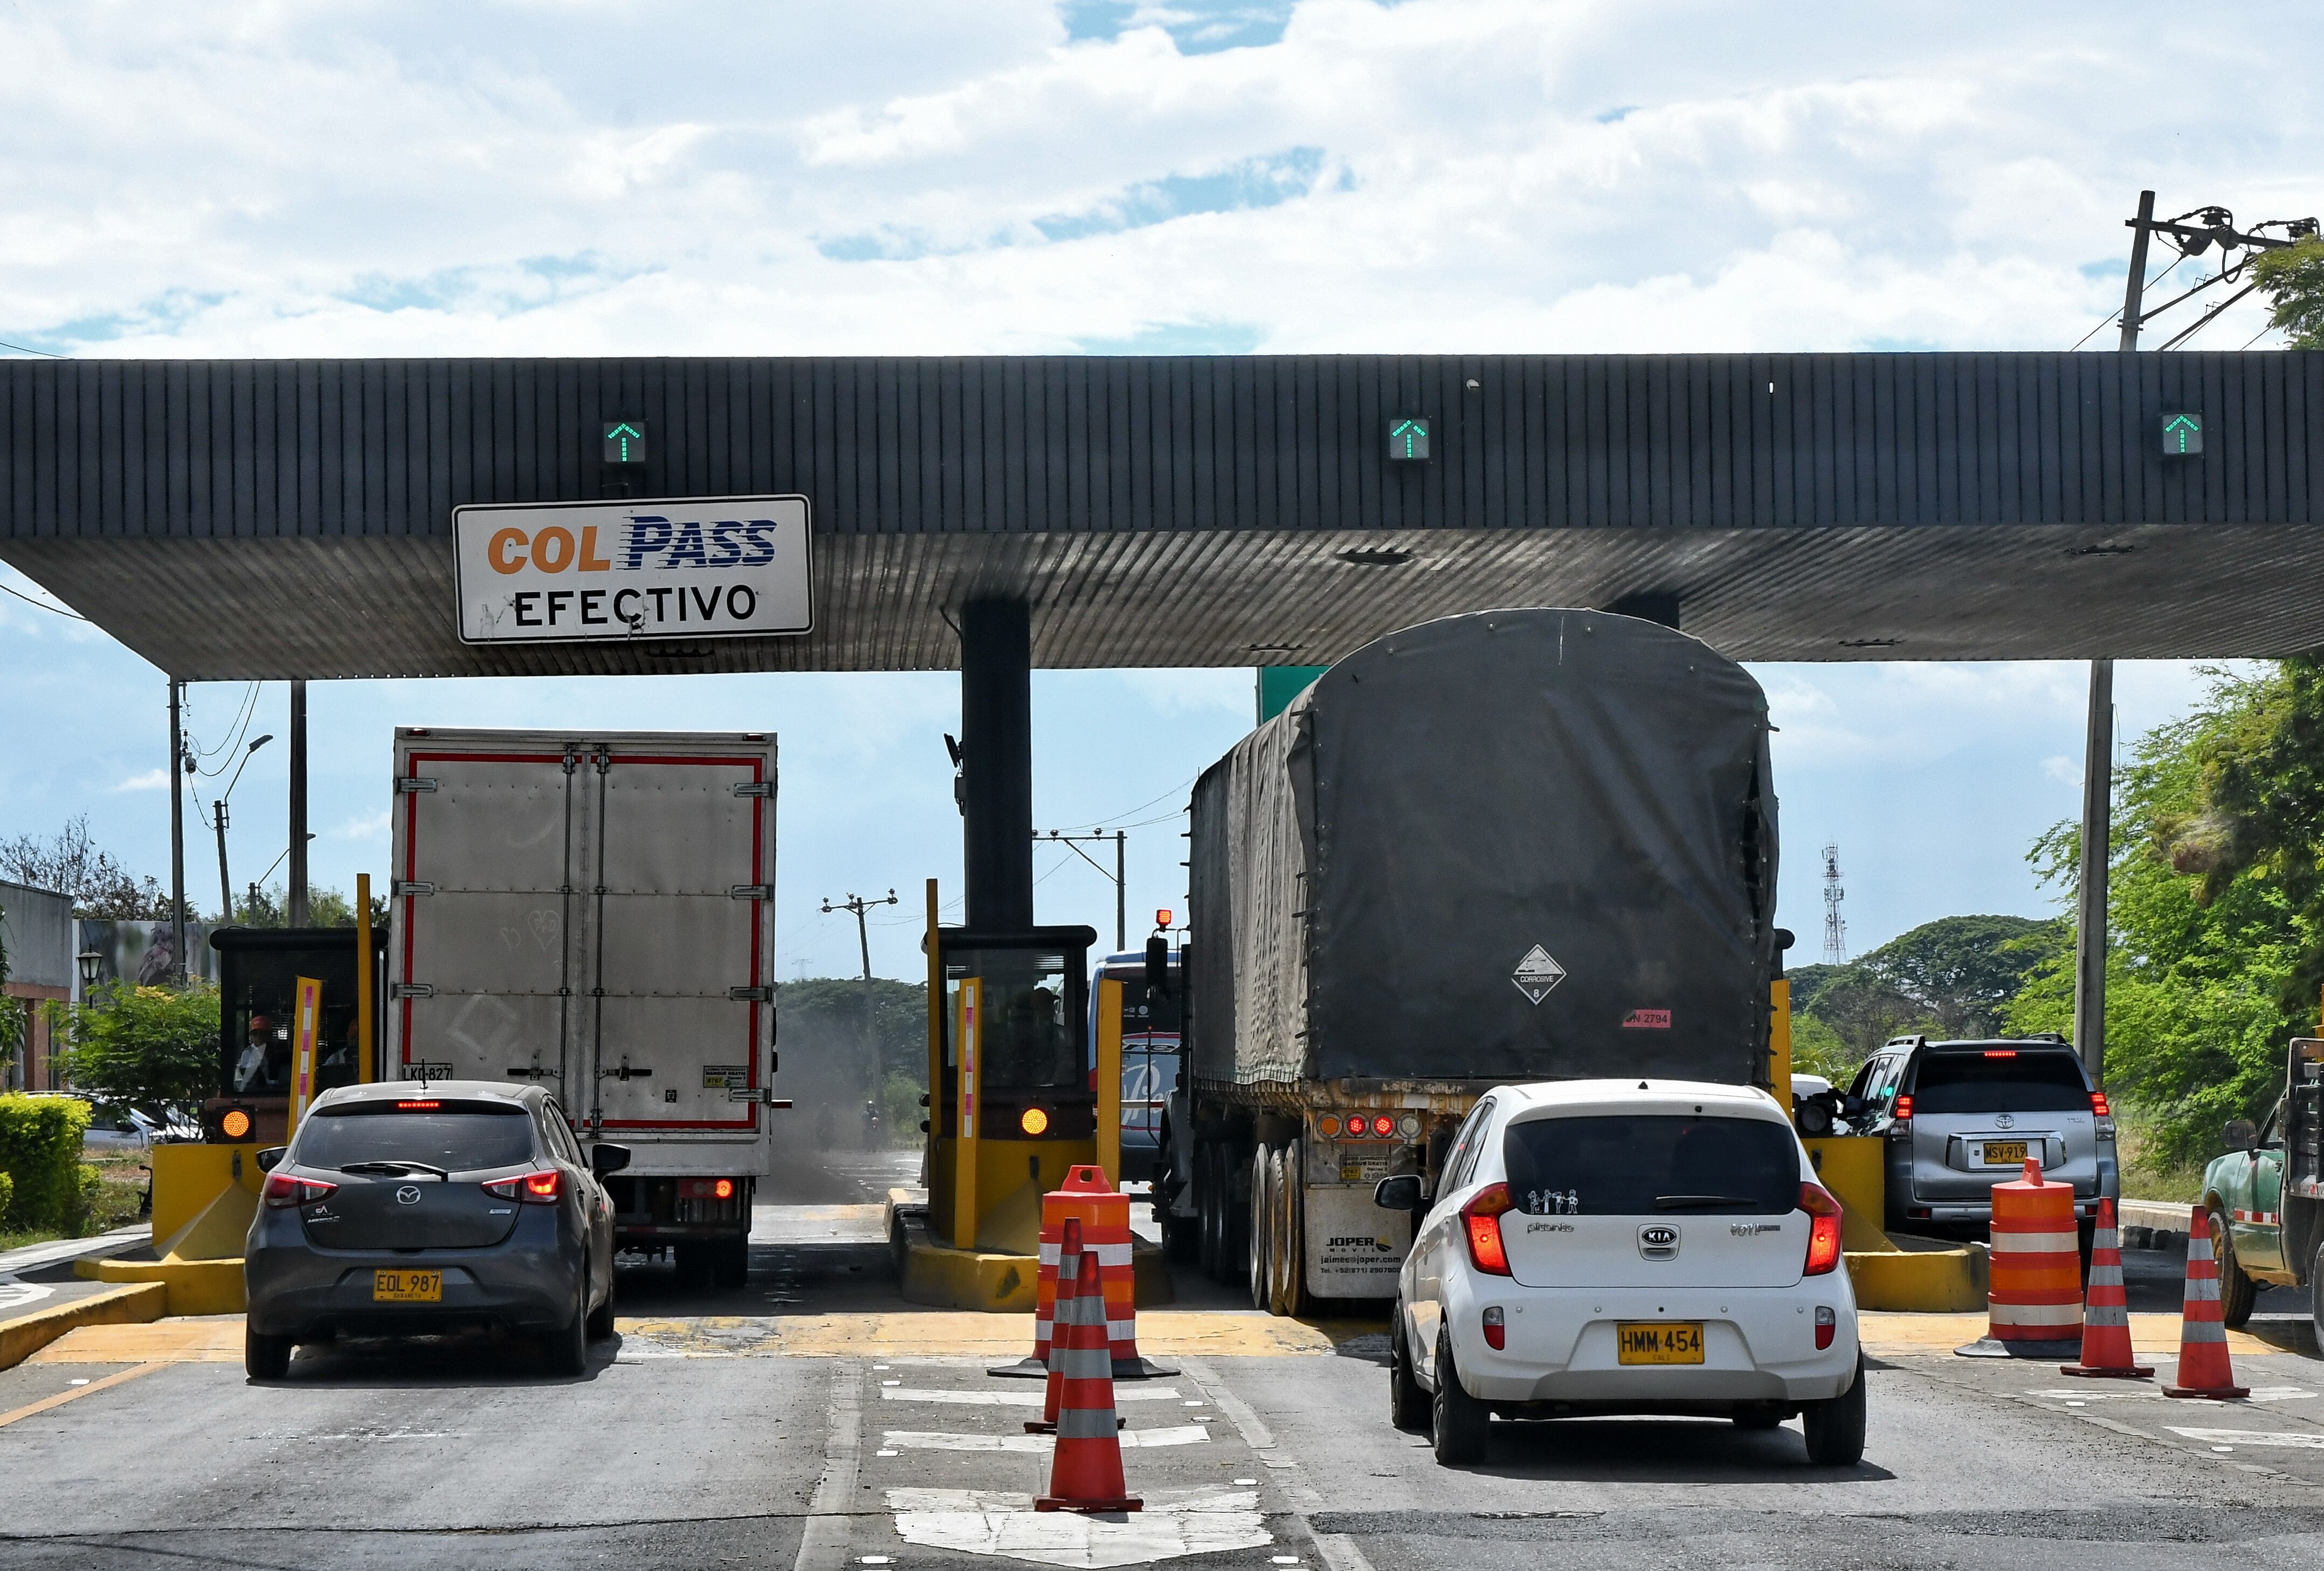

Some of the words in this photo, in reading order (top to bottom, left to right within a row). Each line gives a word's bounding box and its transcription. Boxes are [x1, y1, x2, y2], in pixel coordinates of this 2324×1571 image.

[487, 525, 611, 575] COL
[616, 515, 778, 571] PASS
[515, 585, 756, 627] EFECTIVO
[1533, 988, 1540, 998] 8
[1644, 1014, 1668, 1023] 2794
[1649, 1232, 1671, 1241] KIA
[1326, 1237, 1374, 1246] JOPER
[1321, 1255, 1401, 1264] jaimee@joper.com
